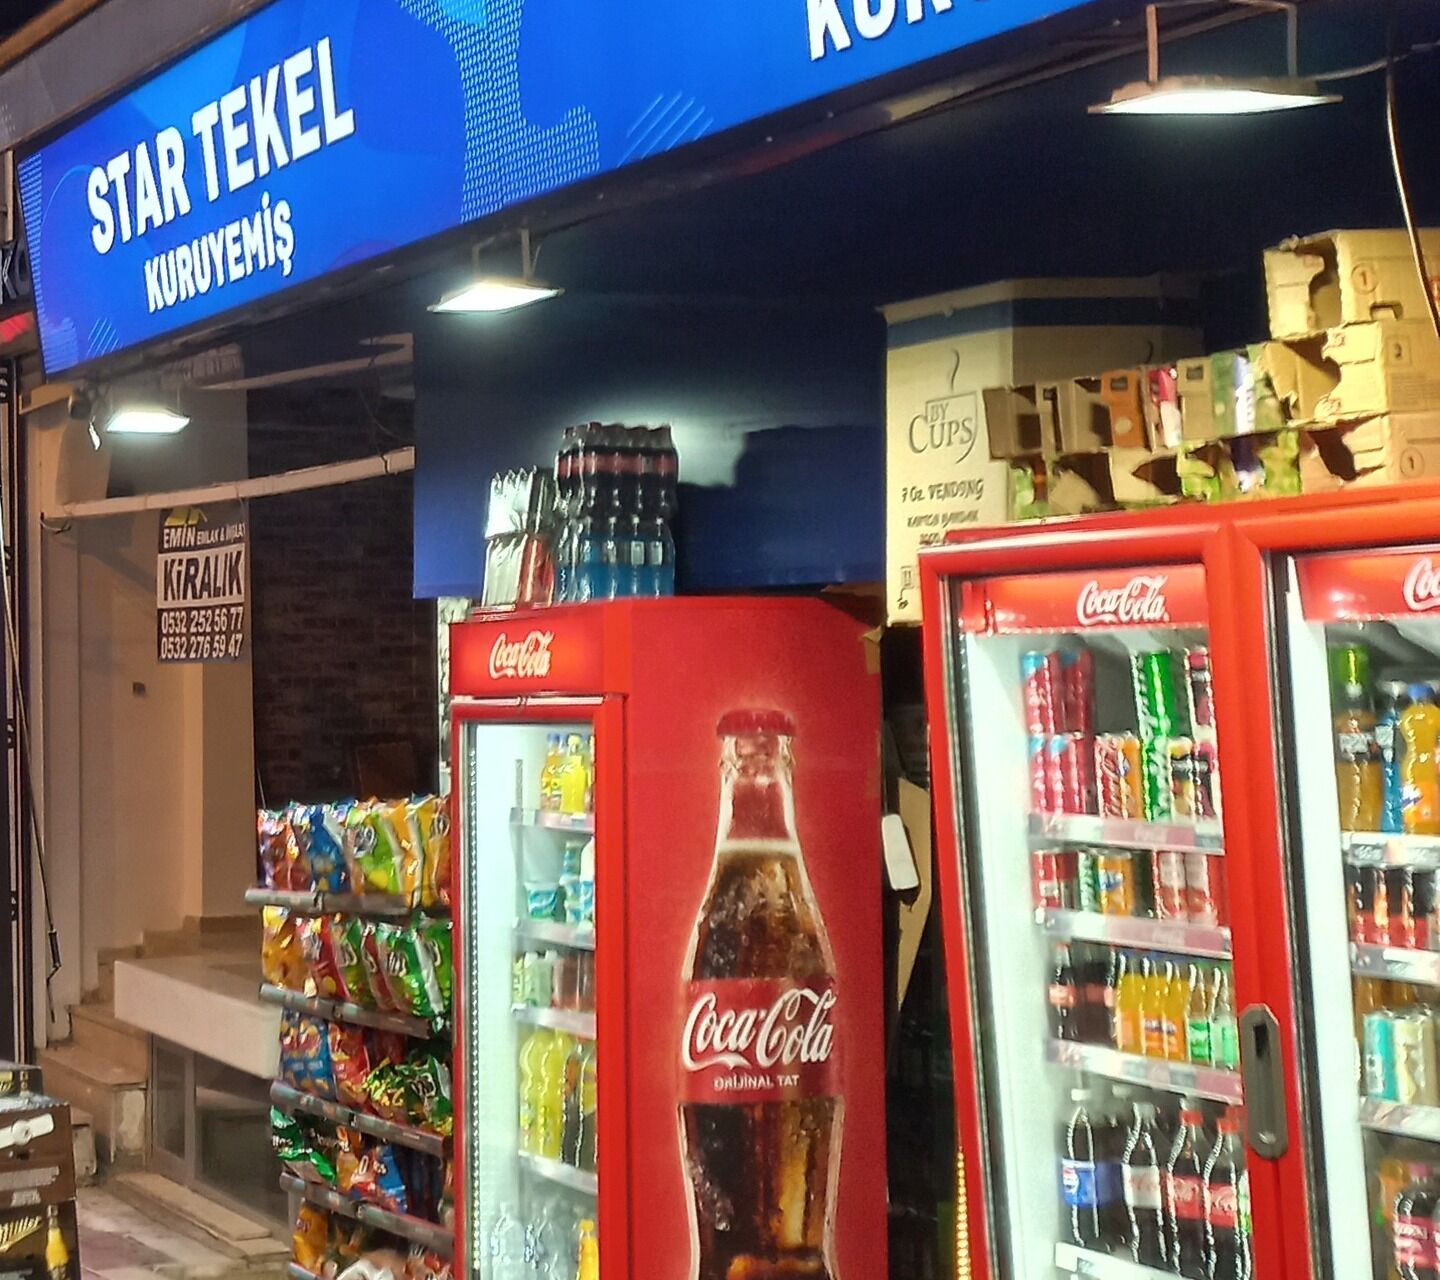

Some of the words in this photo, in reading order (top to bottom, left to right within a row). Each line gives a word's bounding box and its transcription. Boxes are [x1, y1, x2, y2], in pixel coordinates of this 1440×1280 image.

[86, 126, 192, 255] STAR
[191, 35, 355, 201] TEKEL
[143, 198, 294, 314] KURUYEMİŞ
[909, 413, 975, 455] CUPS
[929, 401, 950, 423] BY
[163, 523, 197, 549] EMİN
[163, 549, 243, 602] KİRALIK
[161, 611, 187, 635] 0532
[189, 610, 211, 634] 252
[213, 608, 228, 632] 56
[230, 606, 244, 631] 77
[1075, 574, 1171, 626] Coca-Cola
[160, 637, 187, 659] 0532
[189, 636, 211, 658] 276
[212, 635, 226, 658] 59
[228, 633, 243, 657] 47
[489, 629, 555, 680] Coca-Cola
[681, 987, 837, 1072] Coca-Cola
[776, 1074, 800, 1088] TAT
